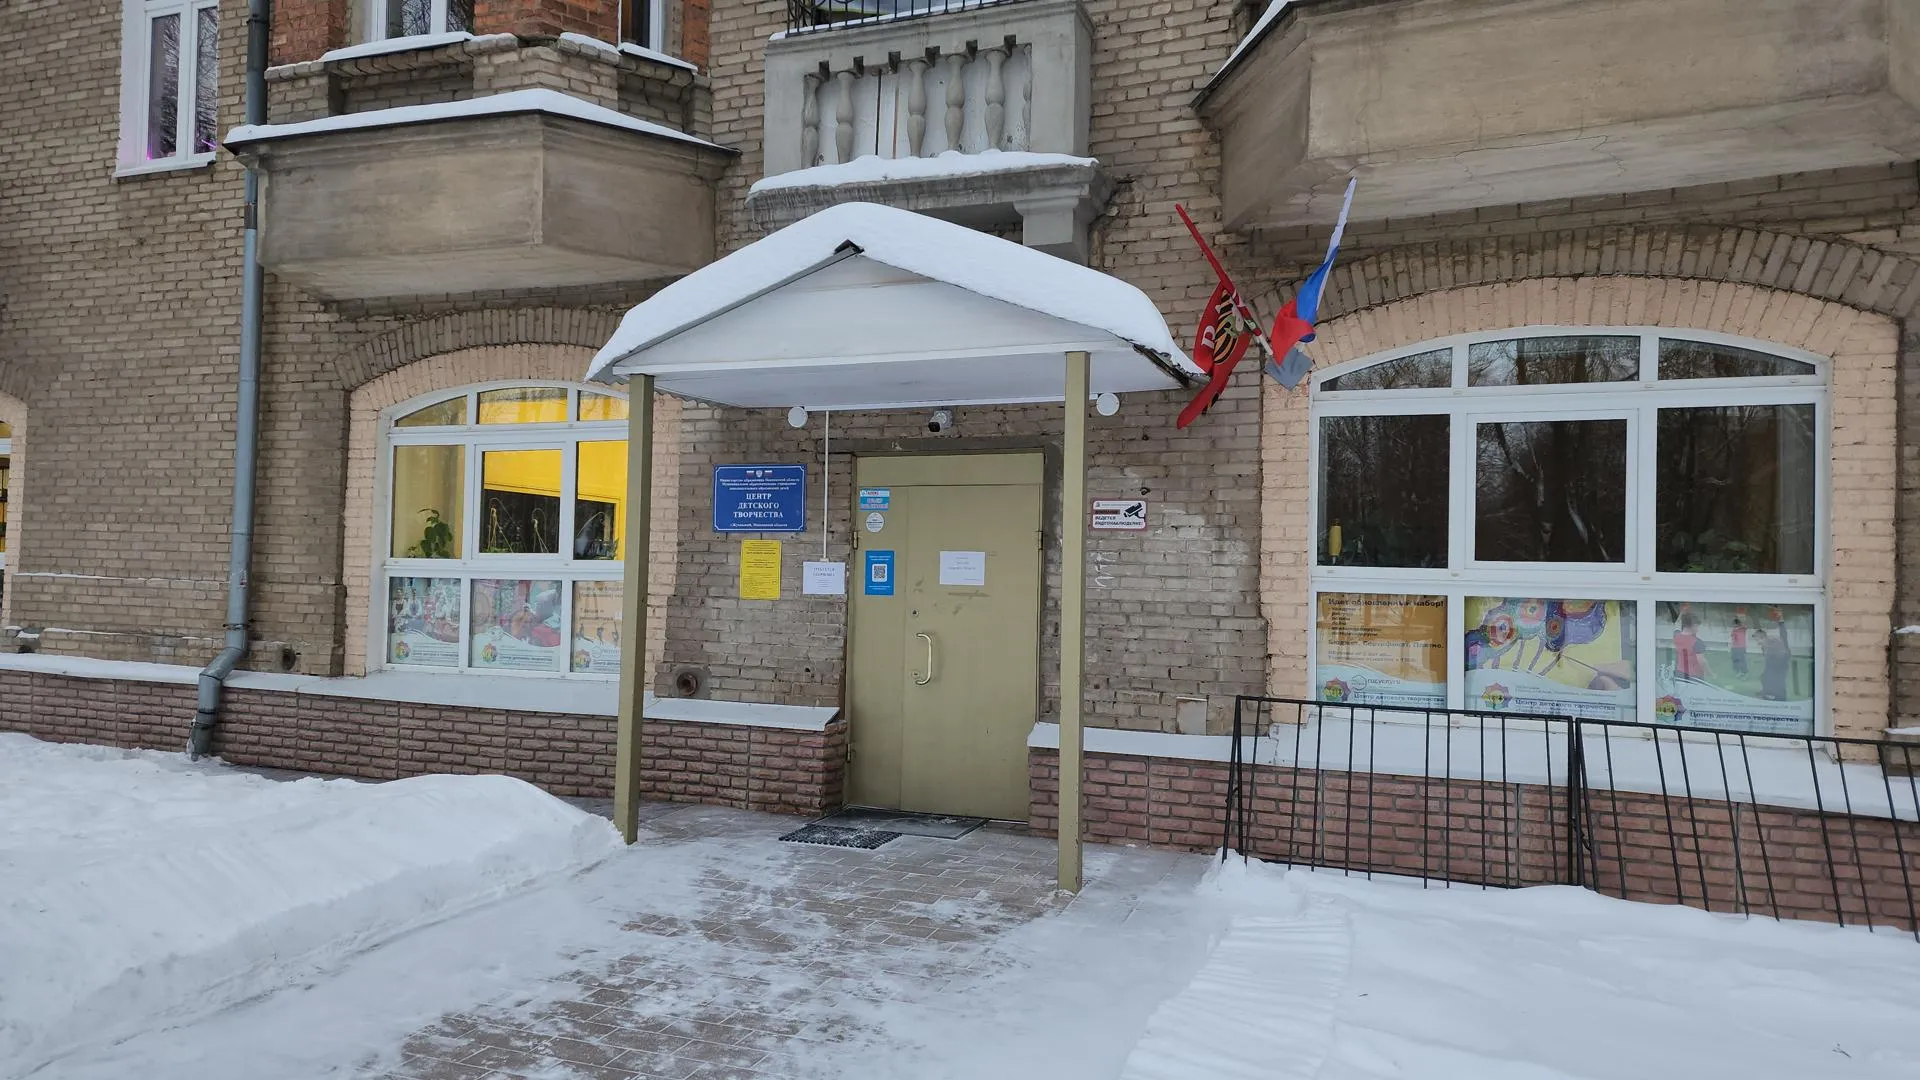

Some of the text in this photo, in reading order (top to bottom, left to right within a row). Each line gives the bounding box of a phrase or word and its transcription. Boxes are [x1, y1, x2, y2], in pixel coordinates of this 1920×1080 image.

[746, 493, 772, 501] ЦЕНТР
[1414, 599, 1444, 608] набор!
[1514, 698, 1538, 706] Центр
[1574, 703, 1616, 711] творчества
[1689, 711, 1715, 719] Центр
[1752, 714, 1800, 723] творчества
